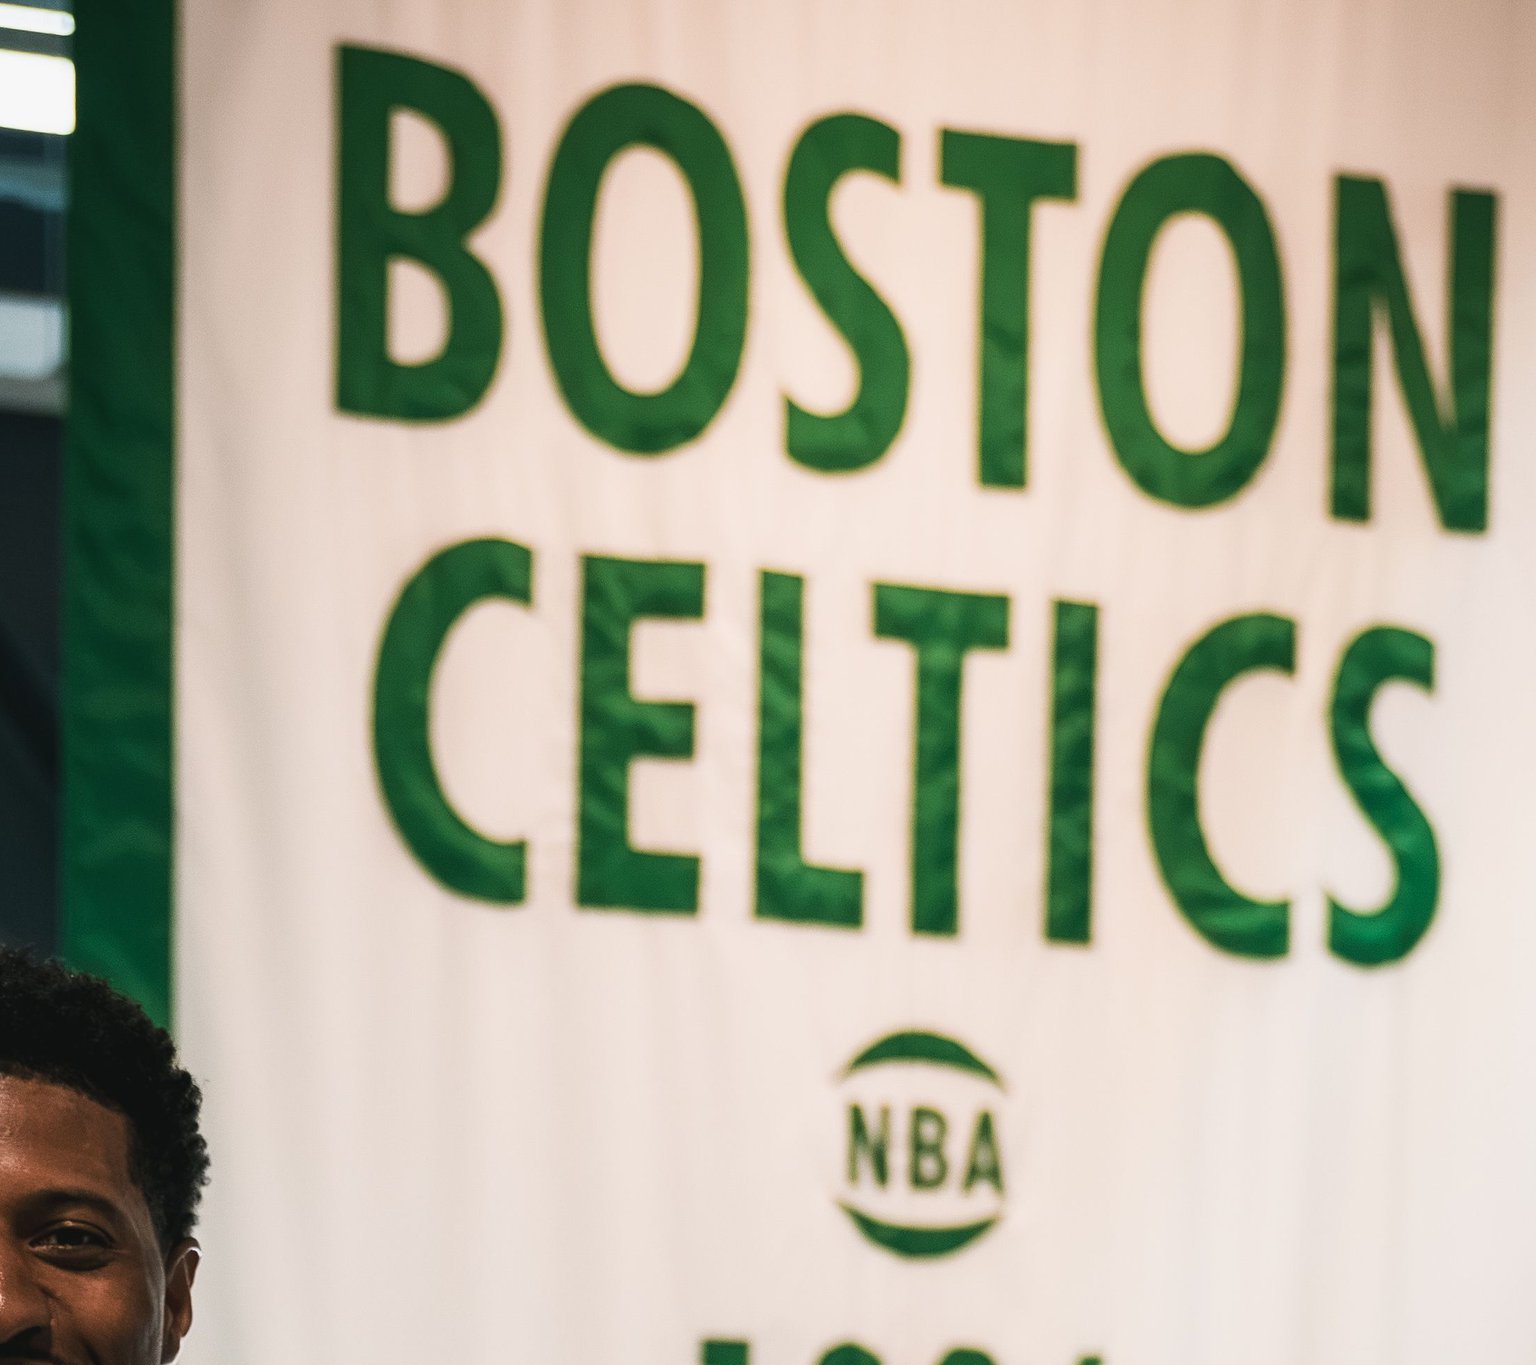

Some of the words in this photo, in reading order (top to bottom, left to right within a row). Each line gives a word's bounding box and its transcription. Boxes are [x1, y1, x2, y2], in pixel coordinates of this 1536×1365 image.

[332, 41, 1500, 536] BOSTON
[371, 537, 1442, 969] CELTICS
[846, 1103, 1005, 1193] NBA
